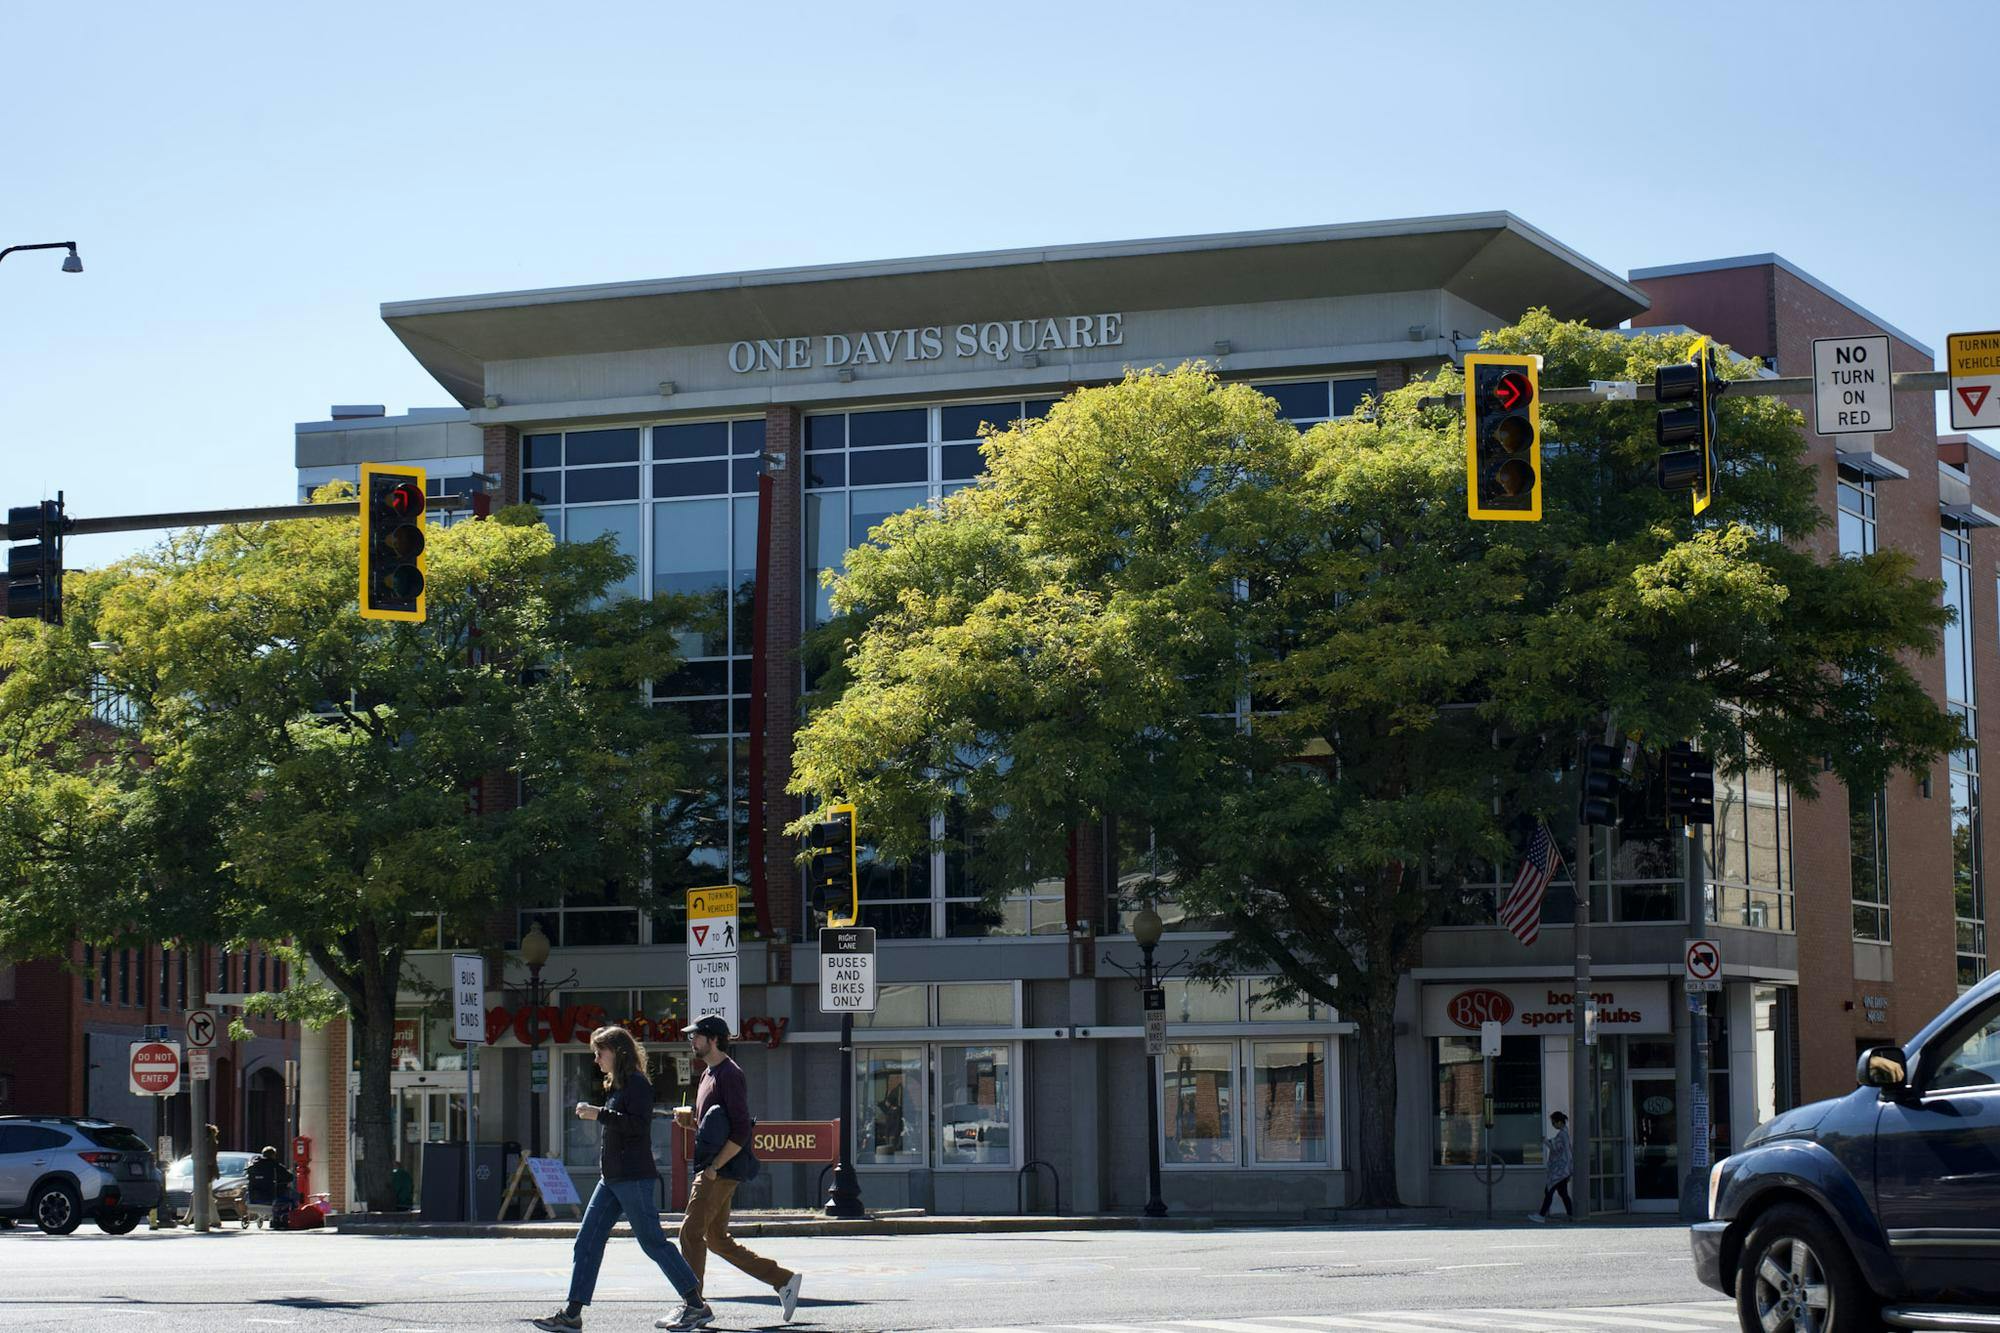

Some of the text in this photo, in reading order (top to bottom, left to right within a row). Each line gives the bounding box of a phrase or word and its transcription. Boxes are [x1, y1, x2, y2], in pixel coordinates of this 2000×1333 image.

[728, 313, 1124, 374] ONE DAVIS SQUARE
[1836, 346, 1867, 364] NO
[1832, 370, 1875, 385] TURN
[1843, 390, 1865, 405] ON
[1838, 411, 1871, 426] RED
[708, 891, 734, 902] TURNING
[707, 903, 735, 914] VEHICLES
[712, 933, 721, 942] TO
[838, 934, 857, 942] RIGHT
[696, 962, 730, 974] U-TURN
[828, 957, 867, 968] BUSES
[461, 971, 476, 986] BUS
[836, 970, 860, 981] AND
[701, 977, 727, 988] YIELD
[831, 983, 865, 994] BIKES
[460, 992, 478, 1007] LANE
[708, 992, 719, 1003] TO
[833, 996, 862, 1007] ONLY
[1548, 990, 1614, 1005] boon
[1456, 992, 1505, 1028] BSC
[460, 1012, 479, 1027] ENDS
[513, 1005, 607, 1045] CVS
[1521, 1010, 1575, 1027] sport
[138, 1053, 172, 1061] DO NOT
[140, 1074, 169, 1083] ENTER
[754, 1134, 816, 1151] SQUARE
